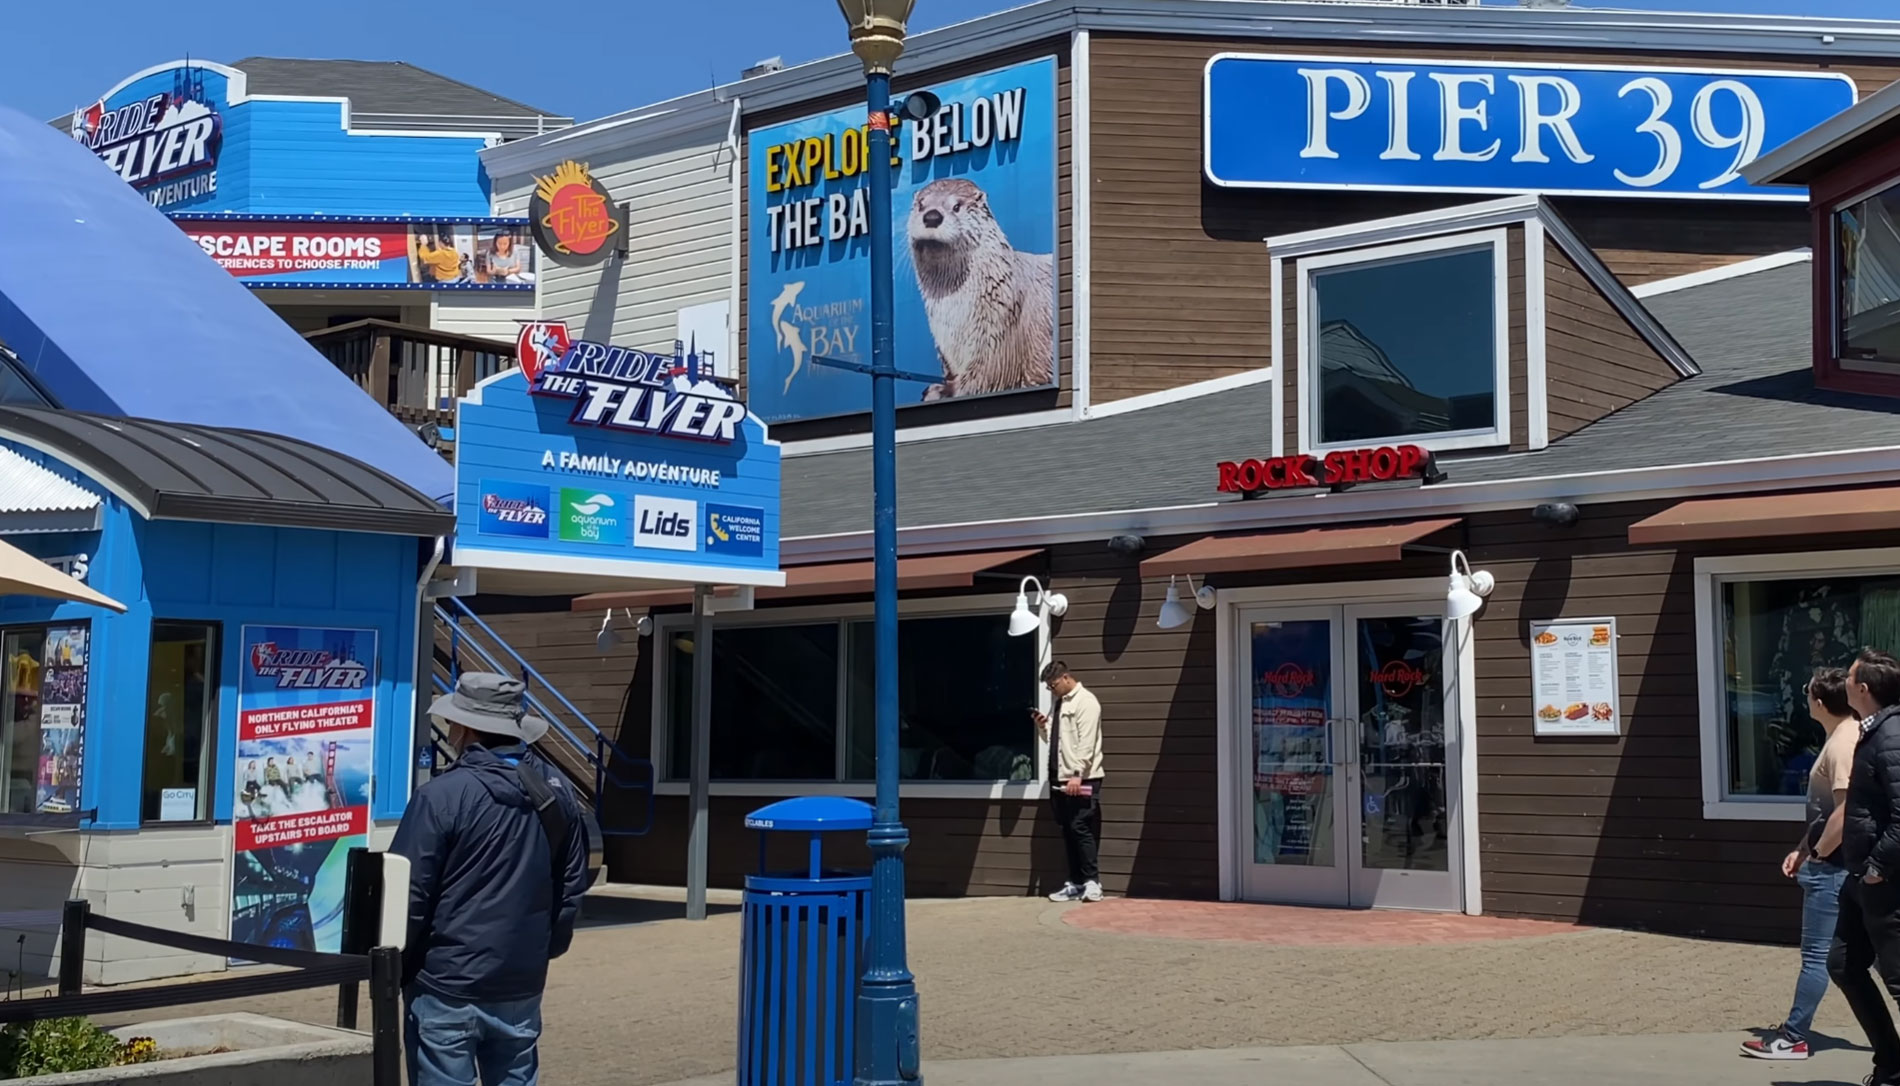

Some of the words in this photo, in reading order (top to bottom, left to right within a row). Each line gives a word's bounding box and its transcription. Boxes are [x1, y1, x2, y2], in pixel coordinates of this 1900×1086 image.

[92, 94, 163, 150] RIDE
[911, 88, 1025, 161] BELOW
[1297, 67, 1594, 164] PIER
[1612, 76, 1766, 190] 39
[97, 116, 214, 183] FLYER
[571, 194, 606, 218] The
[553, 206, 606, 242] Flyer
[767, 197, 821, 252] THE
[829, 186, 870, 241] BA
[292, 236, 381, 258] ROOMS
[277, 258, 292, 269] TO
[294, 258, 342, 269] CHOOSE
[344, 259, 380, 270] FROM!
[792, 298, 862, 325] AQUARIUM
[810, 325, 859, 356] BAY
[566, 341, 675, 386] RIDE
[542, 374, 585, 395] THE
[582, 382, 746, 440] FLYER
[542, 450, 555, 468] A
[560, 452, 622, 476] FAMILY
[624, 461, 720, 486] ADVENTURE
[1217, 454, 1318, 492] ROCK
[1324, 444, 1429, 484] SHOP
[498, 509, 546, 524] FLYER
[571, 514, 617, 526] aquarium
[640, 509, 690, 537] Lids
[722, 515, 760, 526] CALIFORNIA
[580, 526, 600, 540] bay
[728, 524, 760, 534] WELCOME
[736, 534, 760, 542] CENTER
[273, 650, 330, 666] RIDE
[258, 667, 280, 676] THE
[278, 668, 368, 688] FLYER
[1370, 670, 1395, 682] Hard
[1396, 669, 1422, 683] Rock
[248, 710, 300, 724] NORTHERN
[300, 704, 364, 718] CALIFORNIA'S
[254, 724, 280, 734] ONLY
[282, 720, 316, 732] FLYING
[317, 716, 358, 728] THEATER
[250, 821, 276, 834] TAKE
[277, 818, 297, 830] THE
[298, 812, 352, 827] ESCALATOR
[255, 830, 302, 844] UPSTAIRS
[303, 828, 317, 837] TO
[318, 823, 349, 835] BOARD
